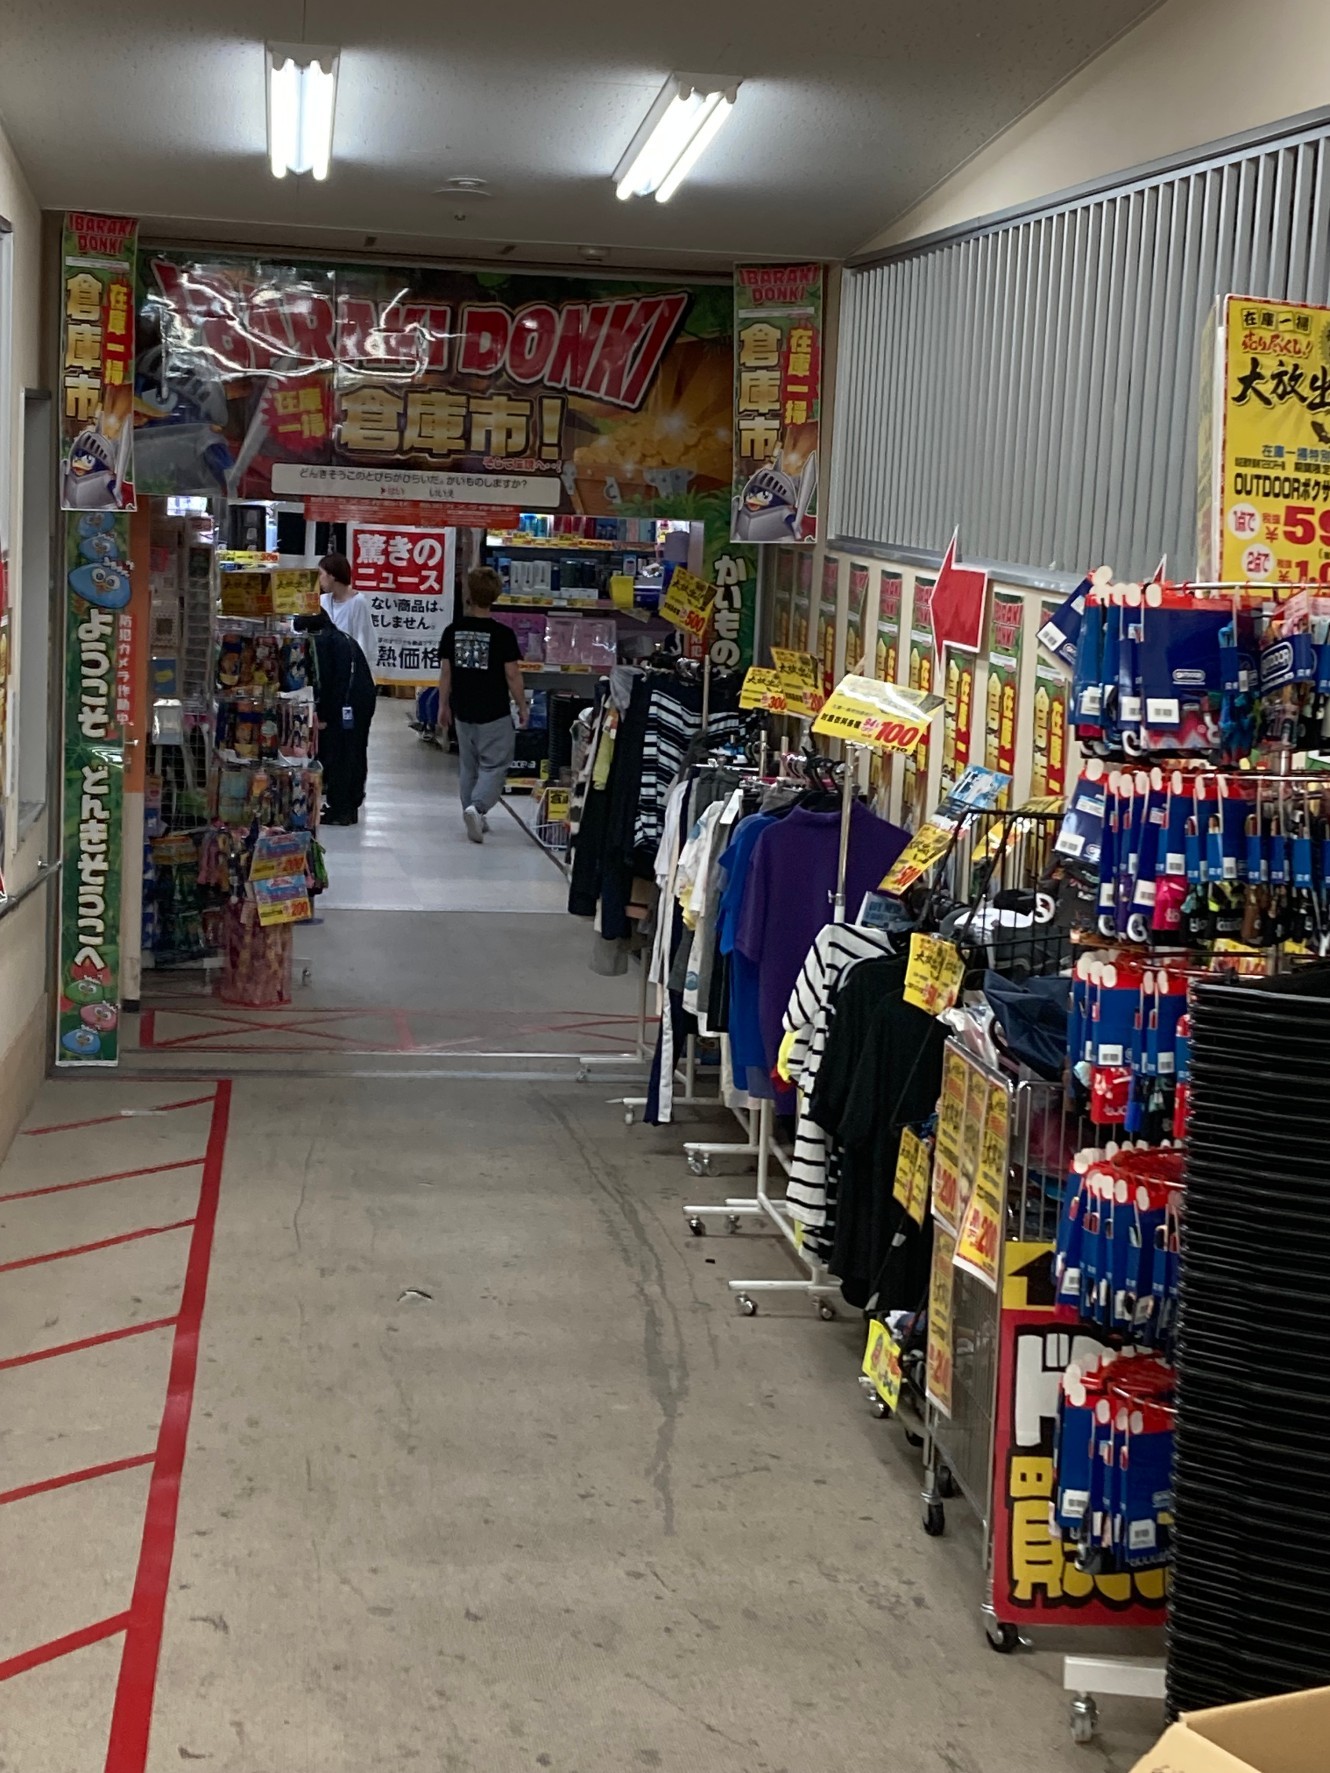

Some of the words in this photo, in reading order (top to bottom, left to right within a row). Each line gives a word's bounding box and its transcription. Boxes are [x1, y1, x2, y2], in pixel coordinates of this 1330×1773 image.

[69, 212, 138, 237] IBARAKI
[77, 234, 124, 255] DONKI
[739, 265, 820, 286] IBARAKI
[752, 284, 806, 304] DONKI
[65, 272, 103, 422] 倉庫市
[104, 282, 130, 387] 在庫一掃
[457, 291, 688, 411] DONKI
[784, 326, 814, 426] 在庫一掃
[738, 321, 782, 461] 倉庫市
[355, 531, 443, 568] 驚きの
[353, 566, 442, 593] ニュース
[371, 596, 444, 613] ない商品は、
[710, 554, 748, 671] かいもの
[684, 610, 706, 632] 500
[376, 645, 441, 670] 熱価格
[77, 607, 114, 739] ようこそ
[768, 695, 787, 711] 300
[875, 720, 921, 745] 100
[73, 765, 111, 970] どんきそうこへ
